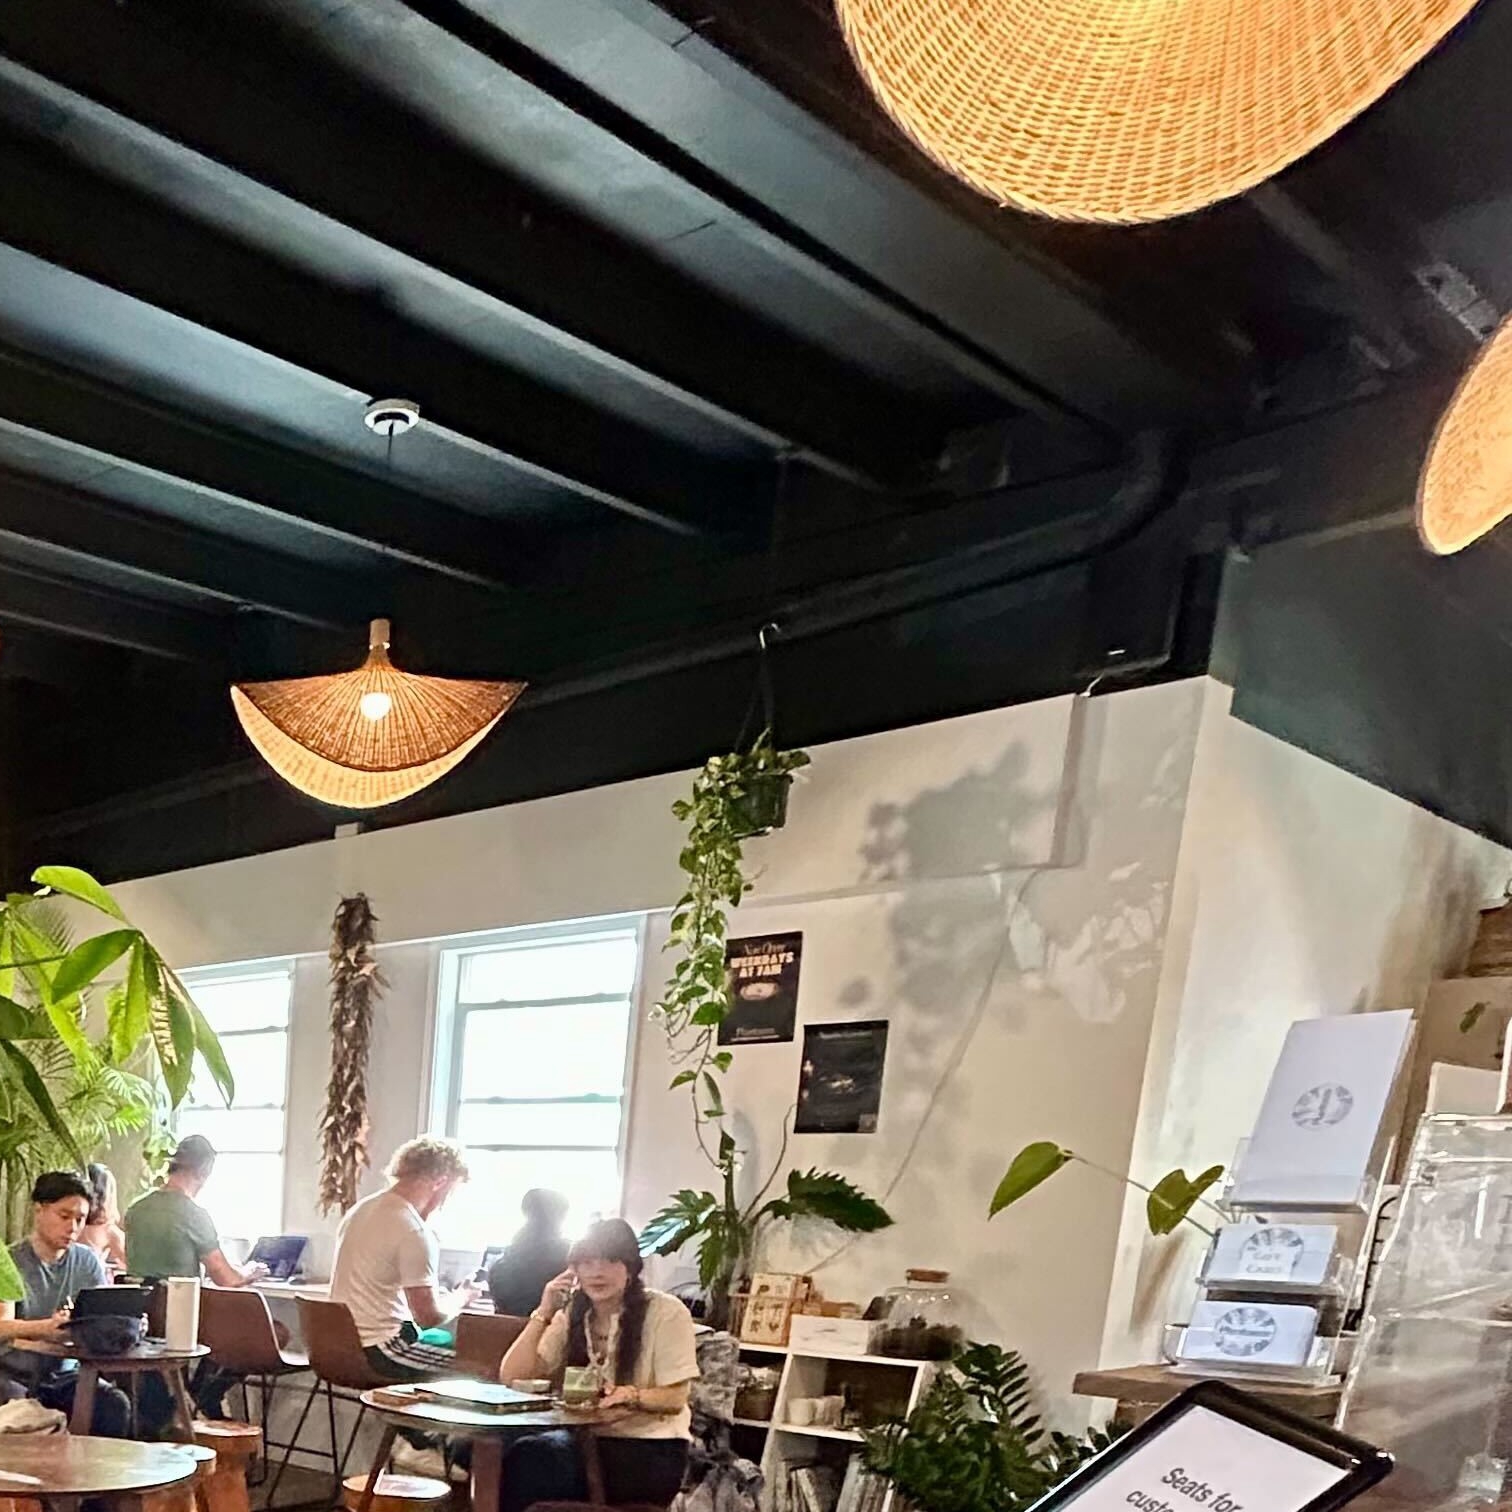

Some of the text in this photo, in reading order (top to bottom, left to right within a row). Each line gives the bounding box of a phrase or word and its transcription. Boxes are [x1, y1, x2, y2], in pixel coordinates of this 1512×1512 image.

[730, 952, 794, 968] WEEKDAYS
[739, 964, 783, 978] AT 7AM
[1161, 1467, 1213, 1502] Seats
